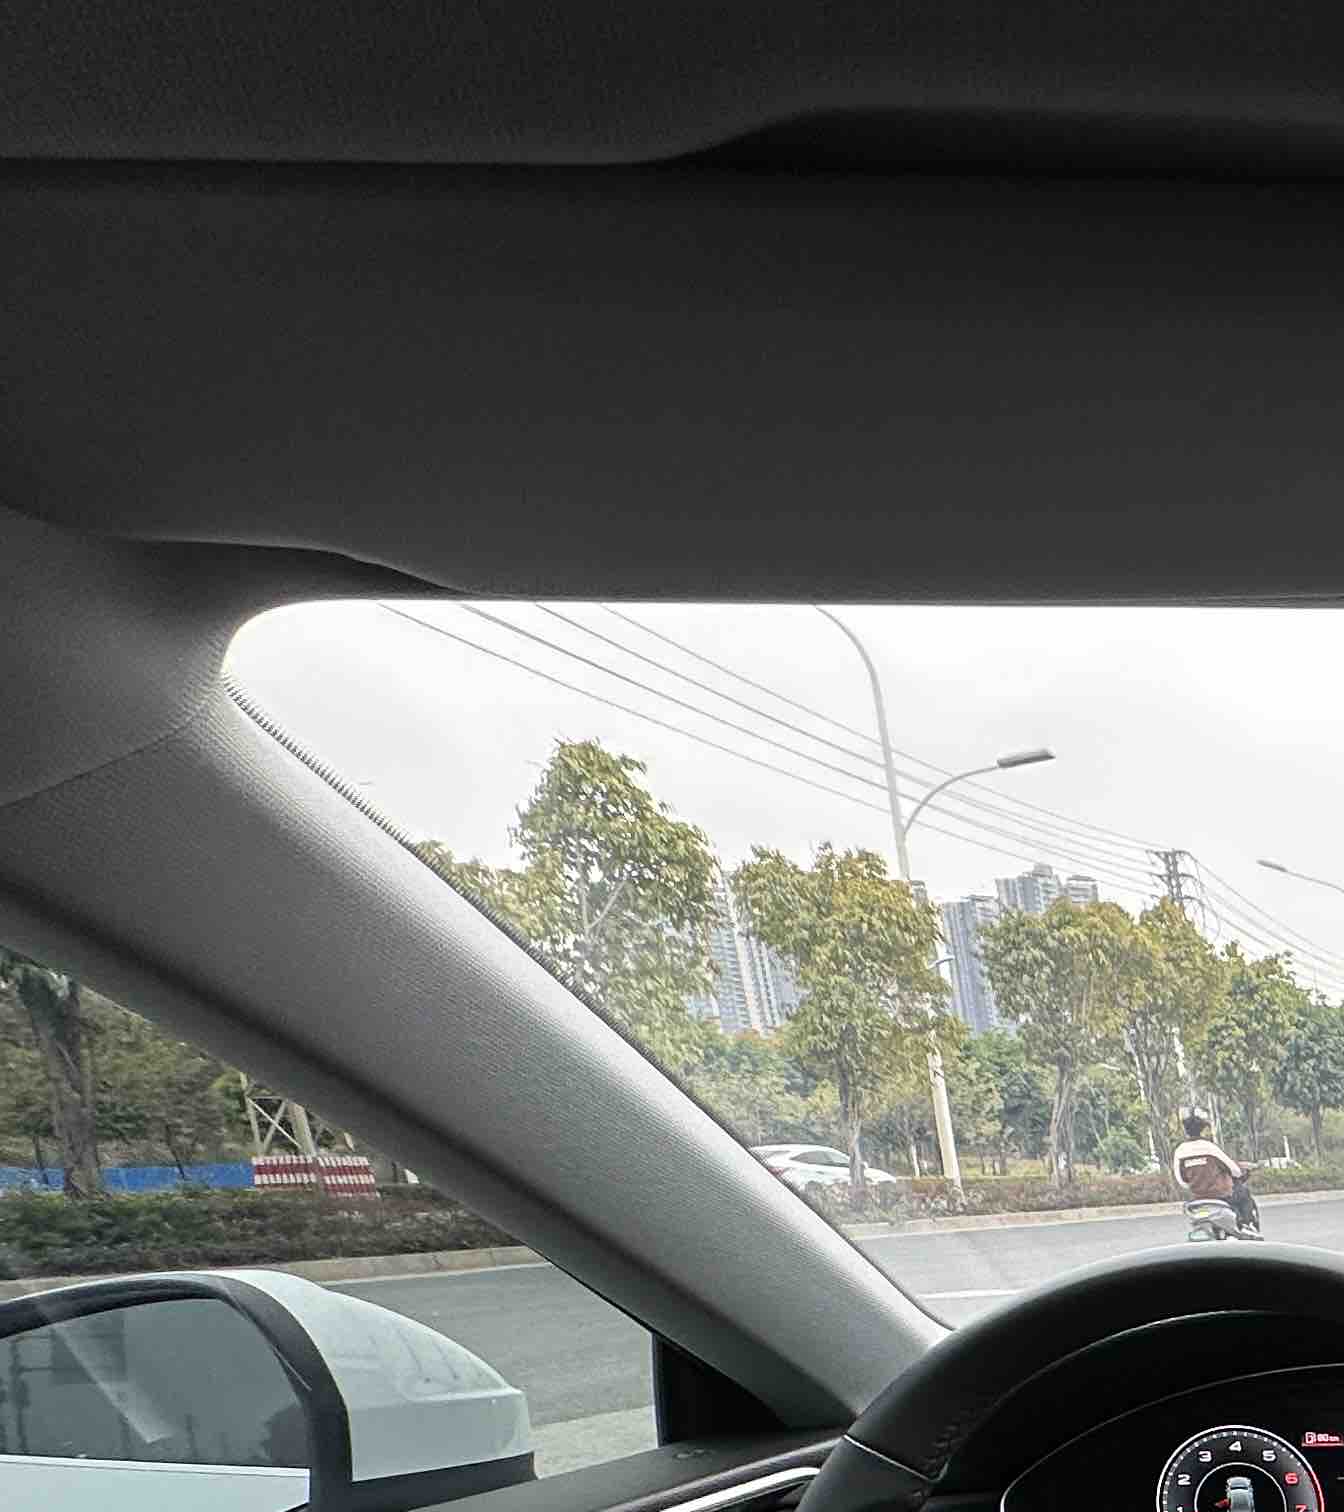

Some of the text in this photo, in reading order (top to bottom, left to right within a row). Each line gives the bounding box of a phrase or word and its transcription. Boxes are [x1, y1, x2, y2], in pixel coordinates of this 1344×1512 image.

[1228, 1441, 1242, 1451] 4
[1198, 1450, 1213, 1462] 3
[1262, 1450, 1277, 1462] 5
[1177, 1474, 1192, 1486] 2
[1285, 1473, 1299, 1484] 6
